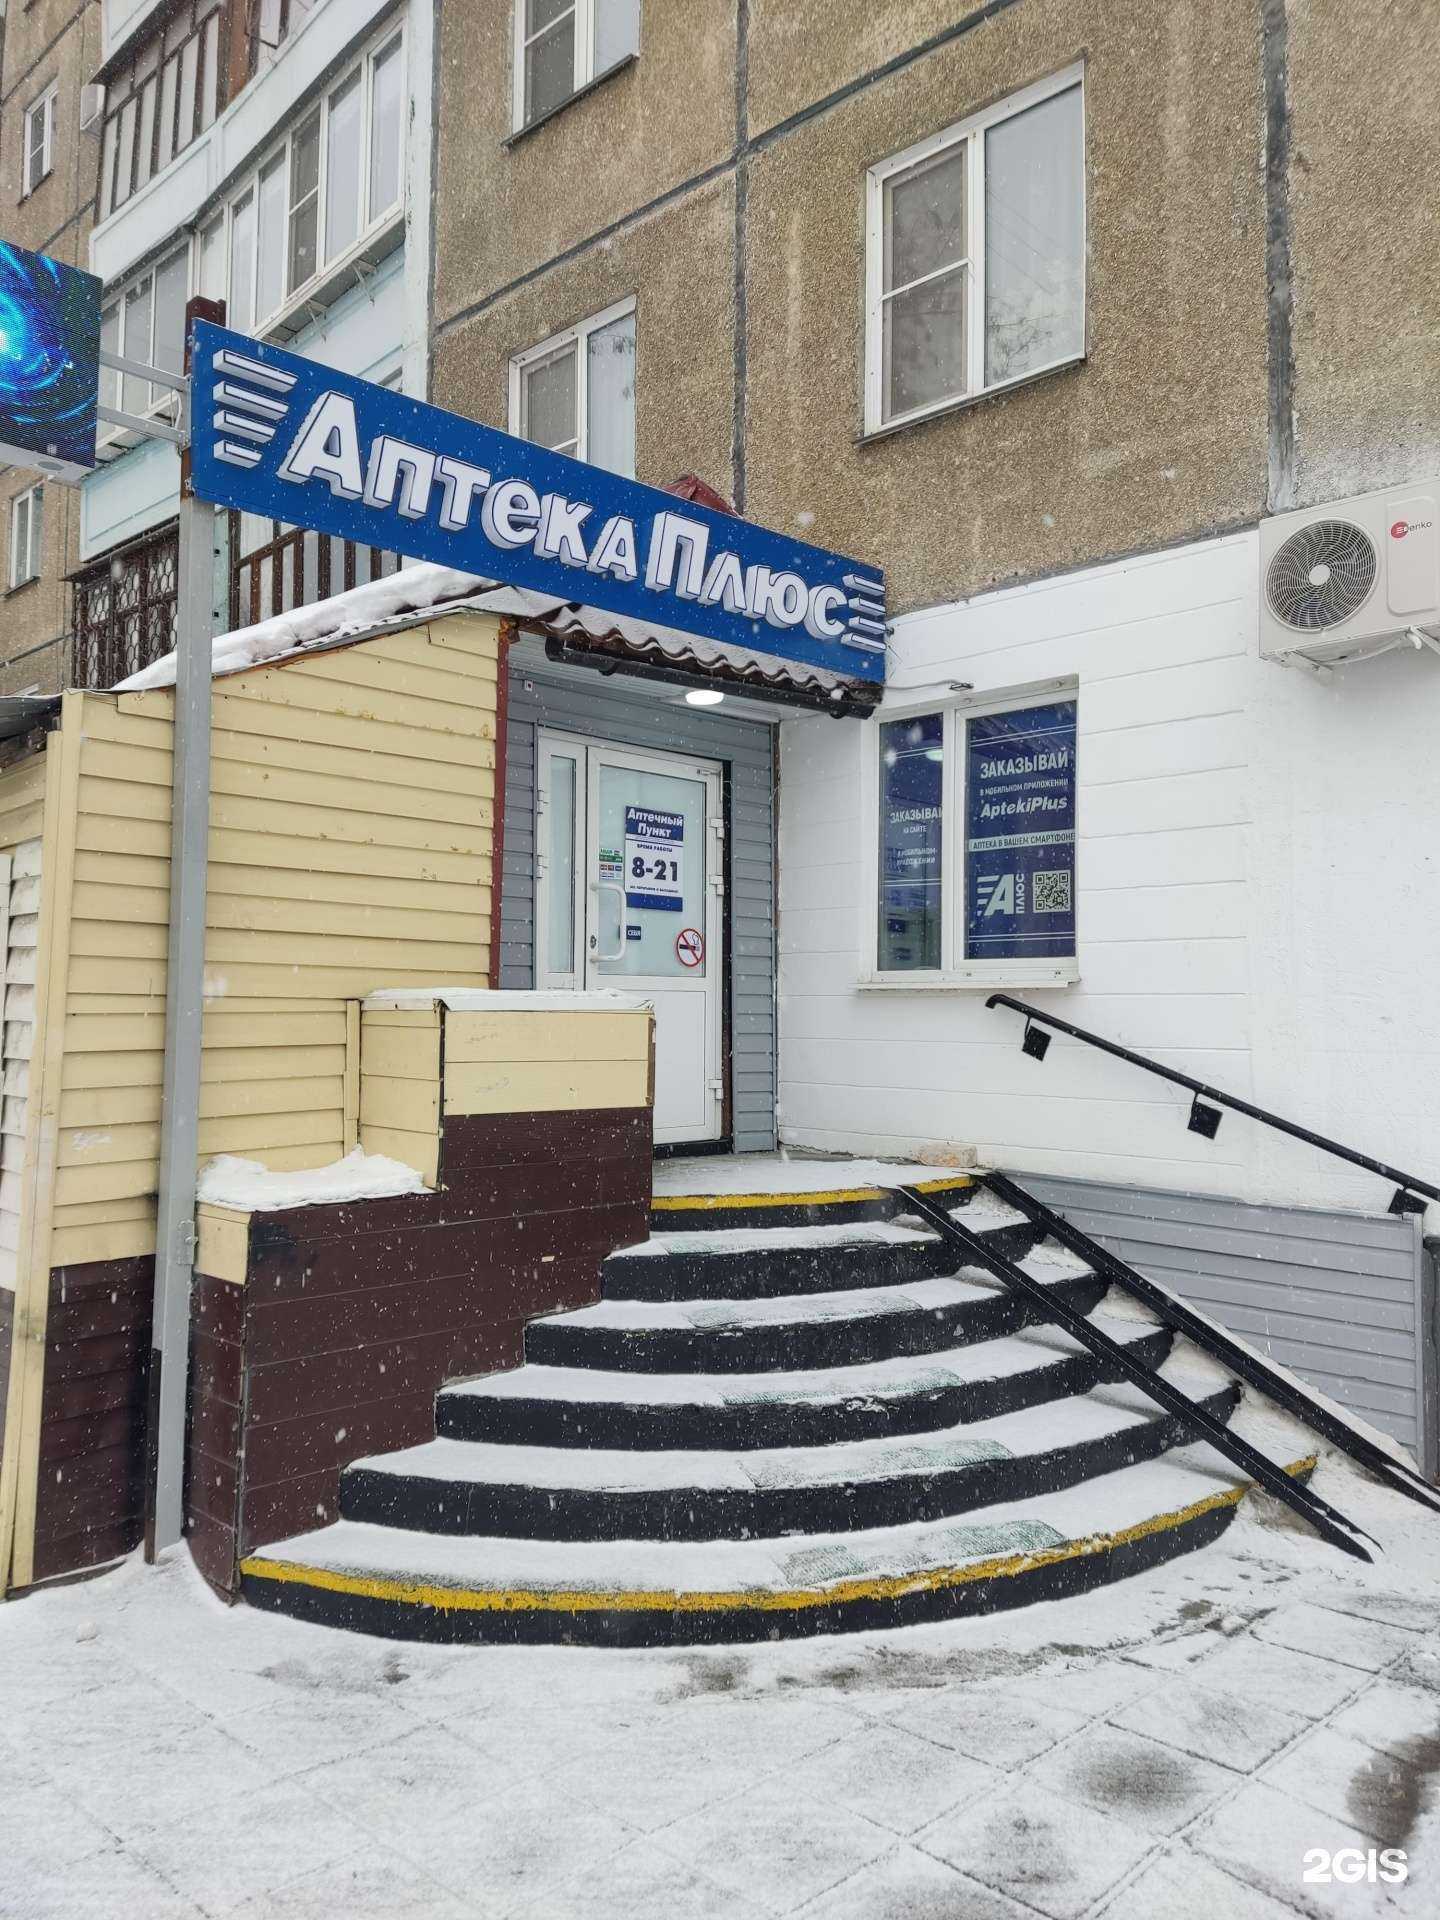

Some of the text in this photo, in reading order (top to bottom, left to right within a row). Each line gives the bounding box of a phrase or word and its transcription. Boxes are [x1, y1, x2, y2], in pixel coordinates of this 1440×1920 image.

[277, 390, 847, 641] Аптека Плюс
[980, 747, 1069, 779] ЗАКАЗЫВАЙ
[985, 783, 1023, 796] МОБИЛЬНОМ
[1023, 778, 1069, 790] ПРИЛОЖЕНИИ
[627, 807, 683, 827] Аптечный
[979, 796, 1068, 820] AptekiPlus
[637, 822, 672, 838] Пункт
[973, 839, 997, 849] АПТЕКА
[1003, 836, 1030, 847] ВАШЕМ
[1030, 832, 1075, 844] СМАРТФОНЕ
[631, 856, 678, 882] 8-21
[1015, 873, 1025, 914] ПЛЮС
